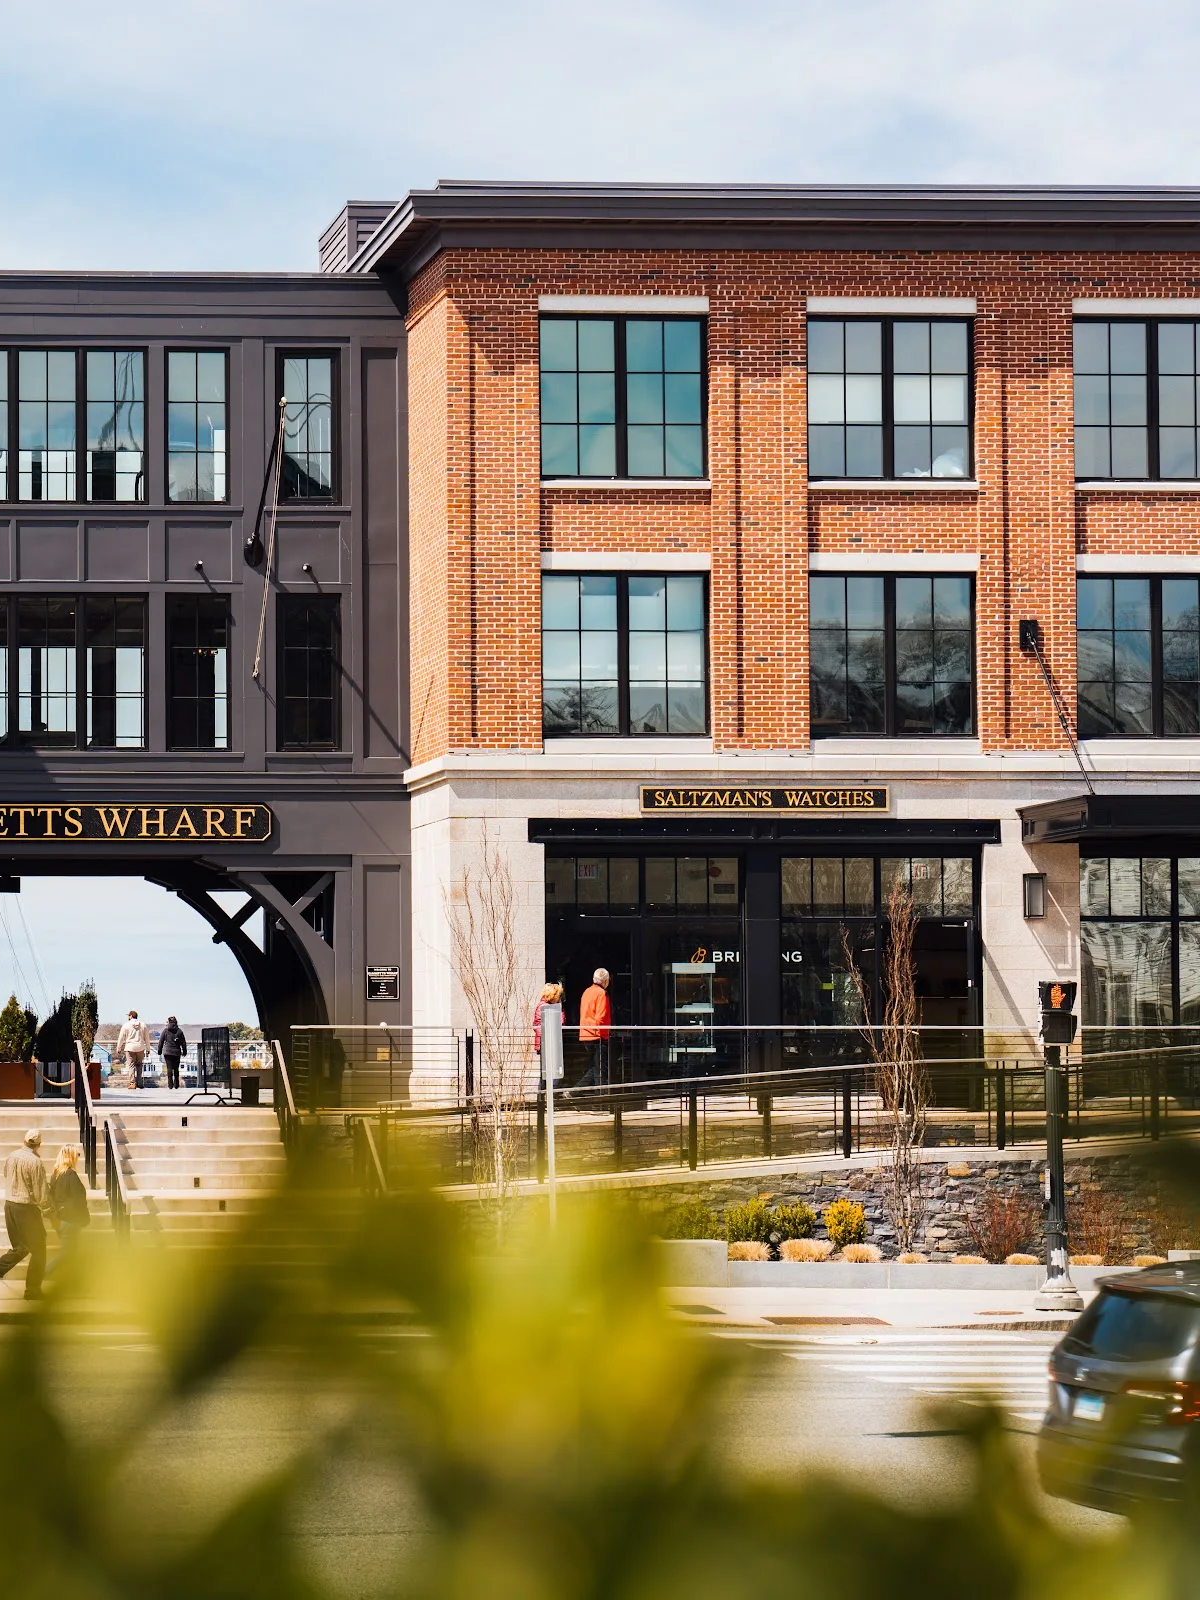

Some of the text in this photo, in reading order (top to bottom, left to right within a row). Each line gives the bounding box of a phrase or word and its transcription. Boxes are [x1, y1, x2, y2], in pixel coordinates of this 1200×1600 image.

[654, 791, 875, 807] SALTZMAN'S WATCHES
[93, 807, 256, 837] WHARF
[578, 864, 596, 877] EXIT
